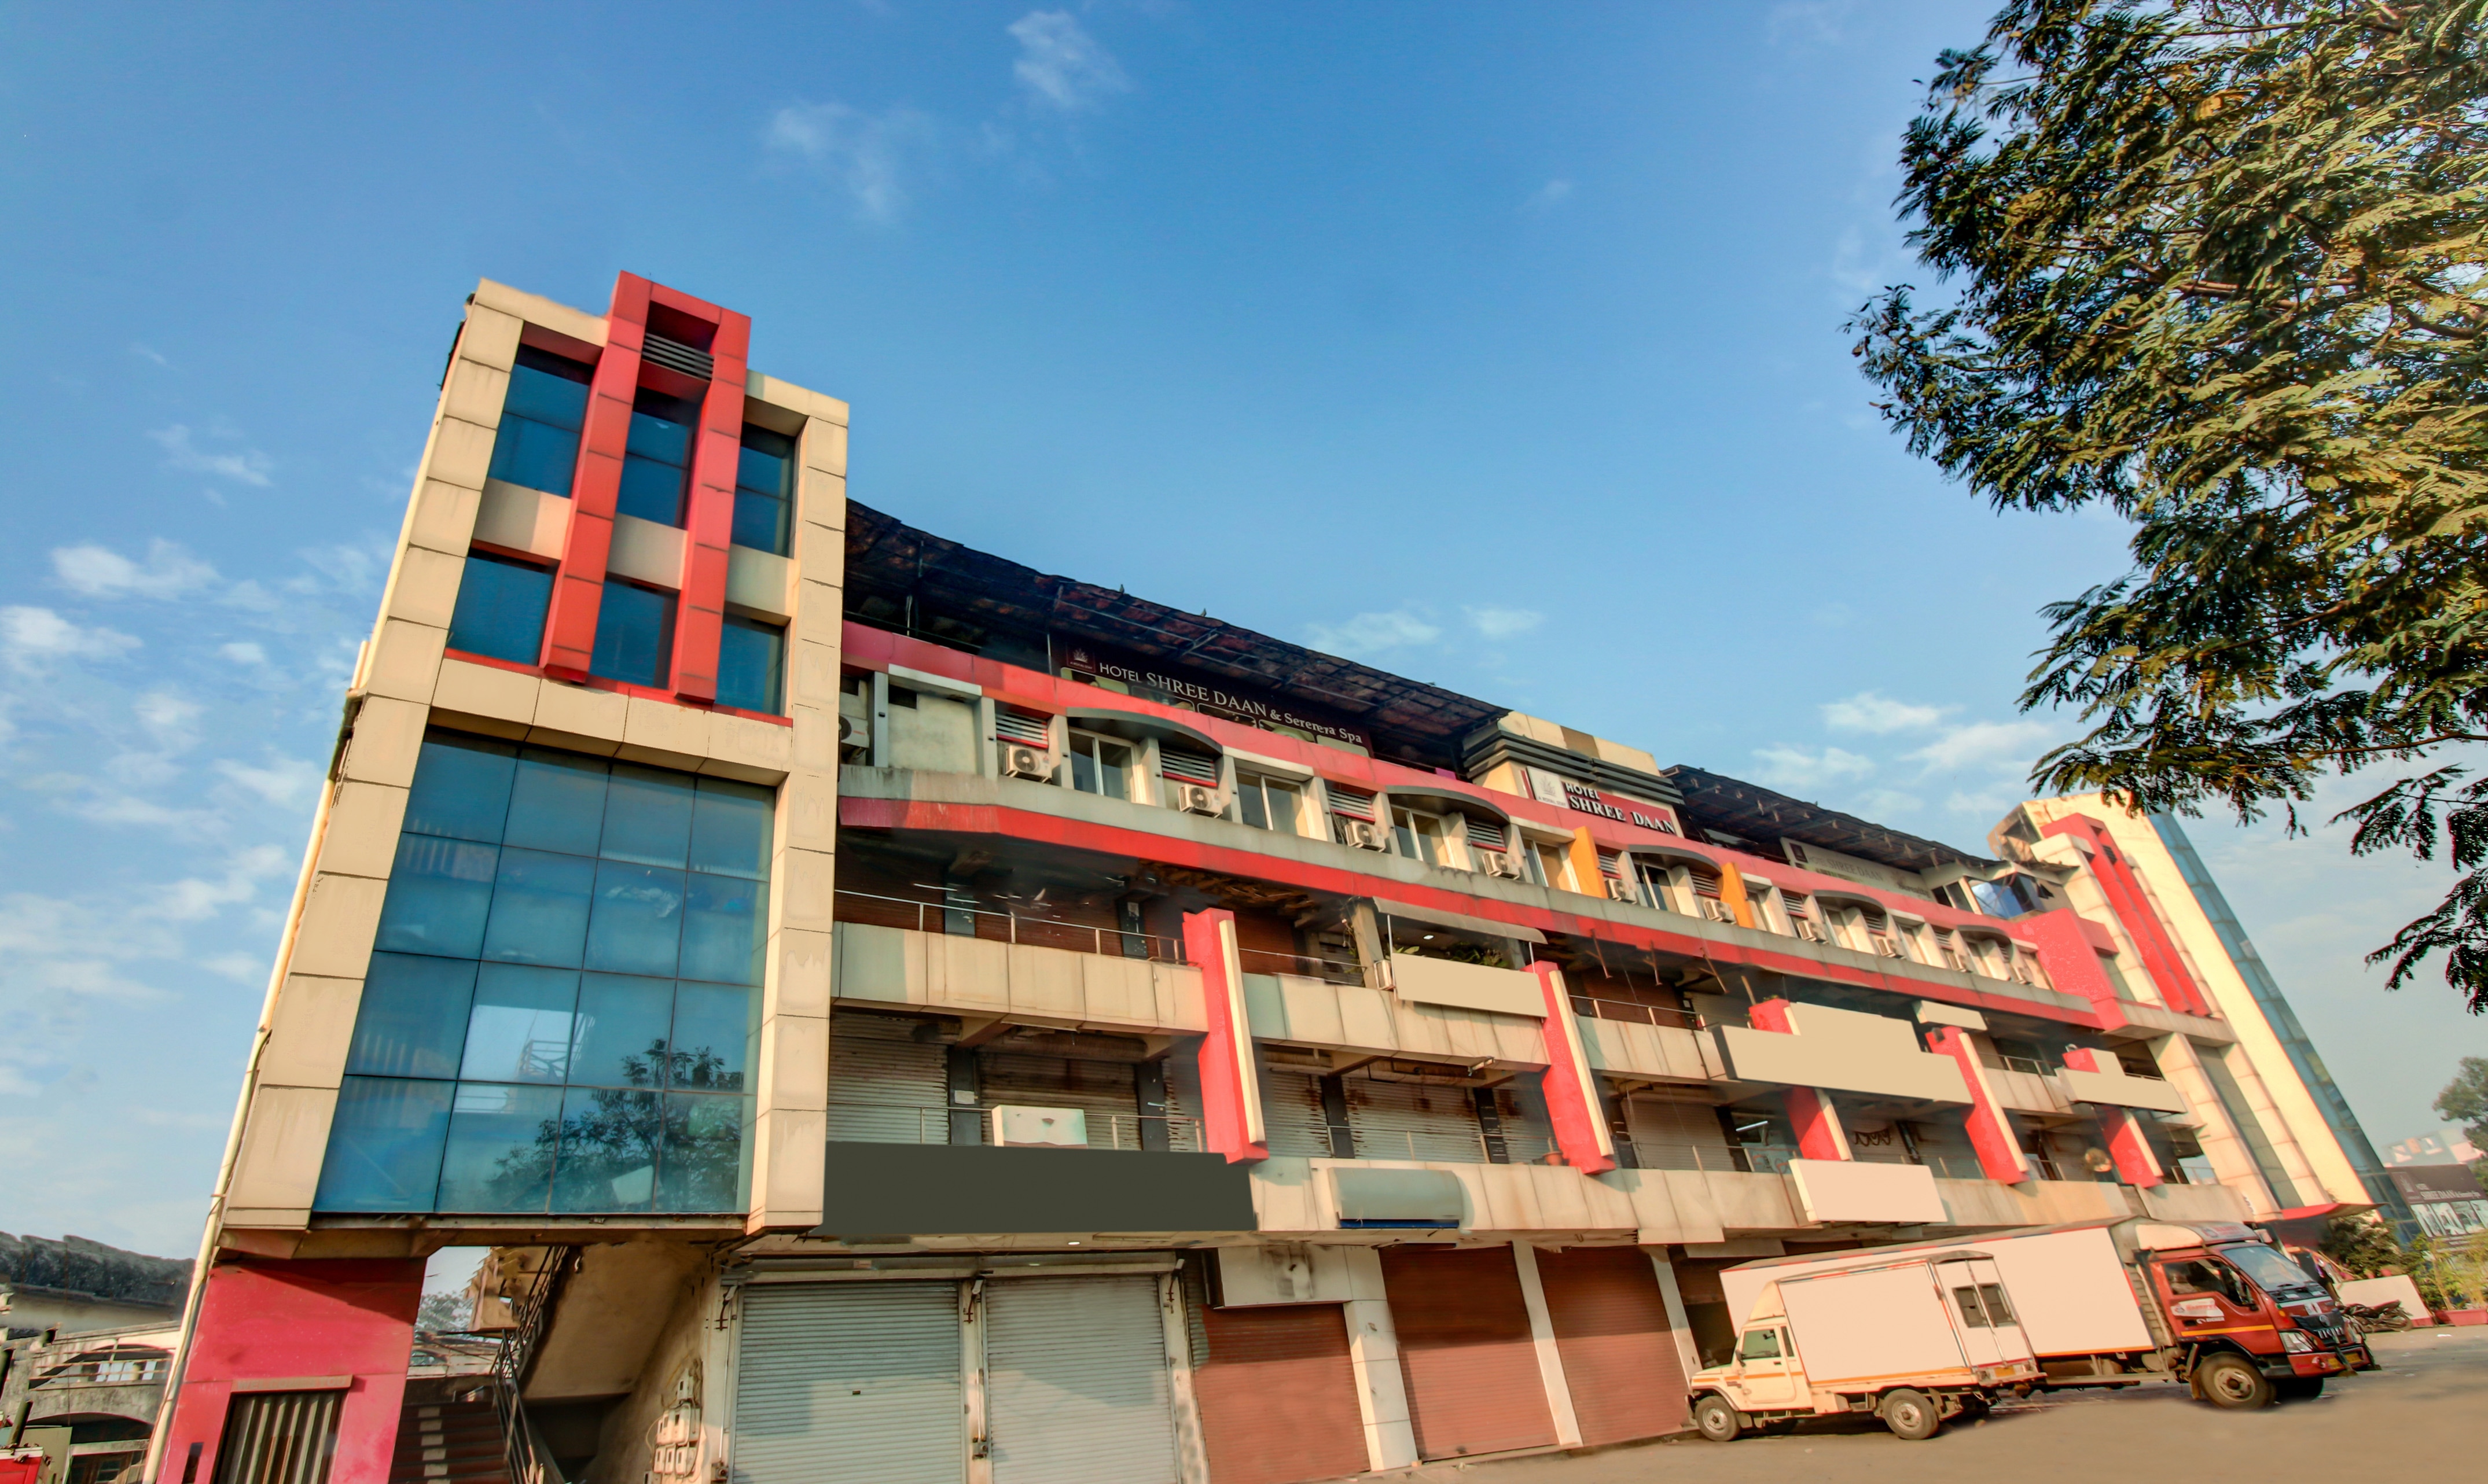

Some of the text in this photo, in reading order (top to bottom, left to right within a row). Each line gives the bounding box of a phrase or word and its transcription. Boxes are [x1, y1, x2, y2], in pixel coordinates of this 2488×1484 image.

[1100, 662, 1142, 683] HOTEL
[1146, 672, 1210, 701] SHREE
[1213, 690, 1267, 717] DAAN
[1270, 709, 1282, 721] &
[1339, 728, 1362, 743] Spa
[1565, 782, 1601, 801] HOTEL
[1569, 795, 1676, 834] SHREE DAAN
[1827, 859, 1857, 874] SHREE
[1857, 867, 1883, 881] DAAN
